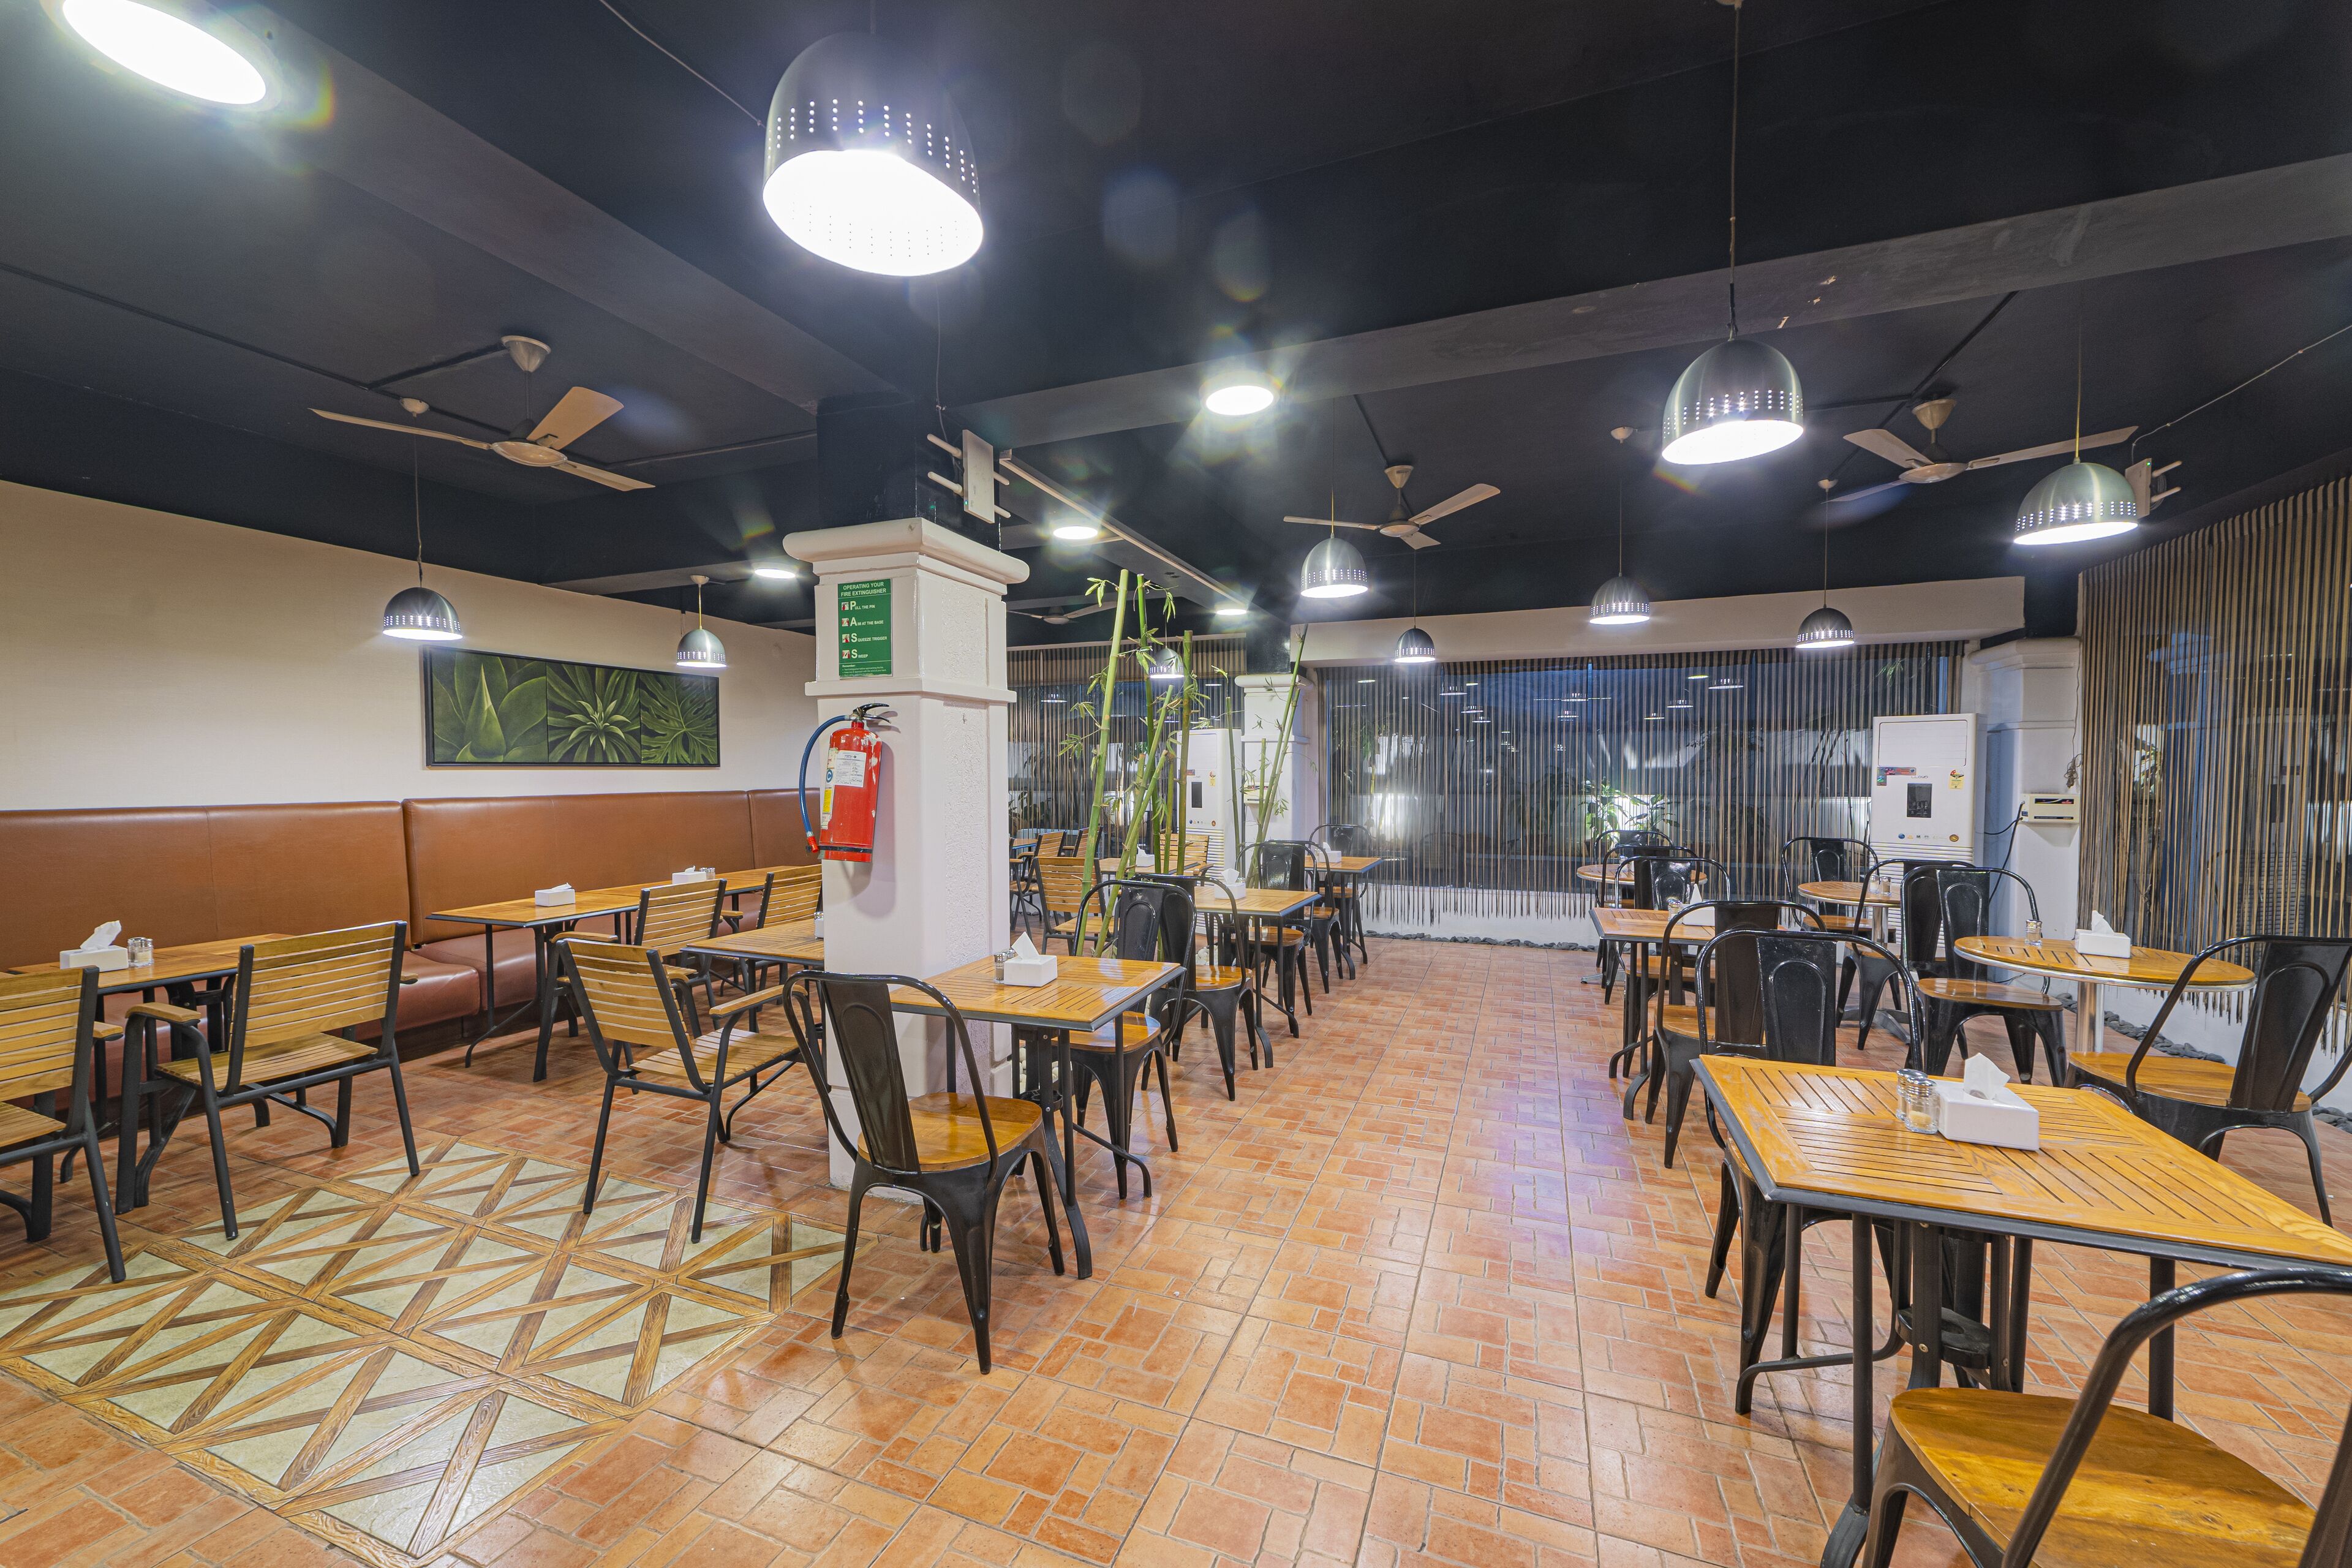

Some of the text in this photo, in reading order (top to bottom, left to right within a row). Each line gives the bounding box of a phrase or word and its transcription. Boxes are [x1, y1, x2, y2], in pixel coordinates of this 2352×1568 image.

[850, 601, 861, 610] PULL
[850, 617, 861, 626] AIM
[851, 633, 871, 643] SQUEEZE
[851, 649, 869, 658] SWEEP
[827, 771, 832, 781] C
